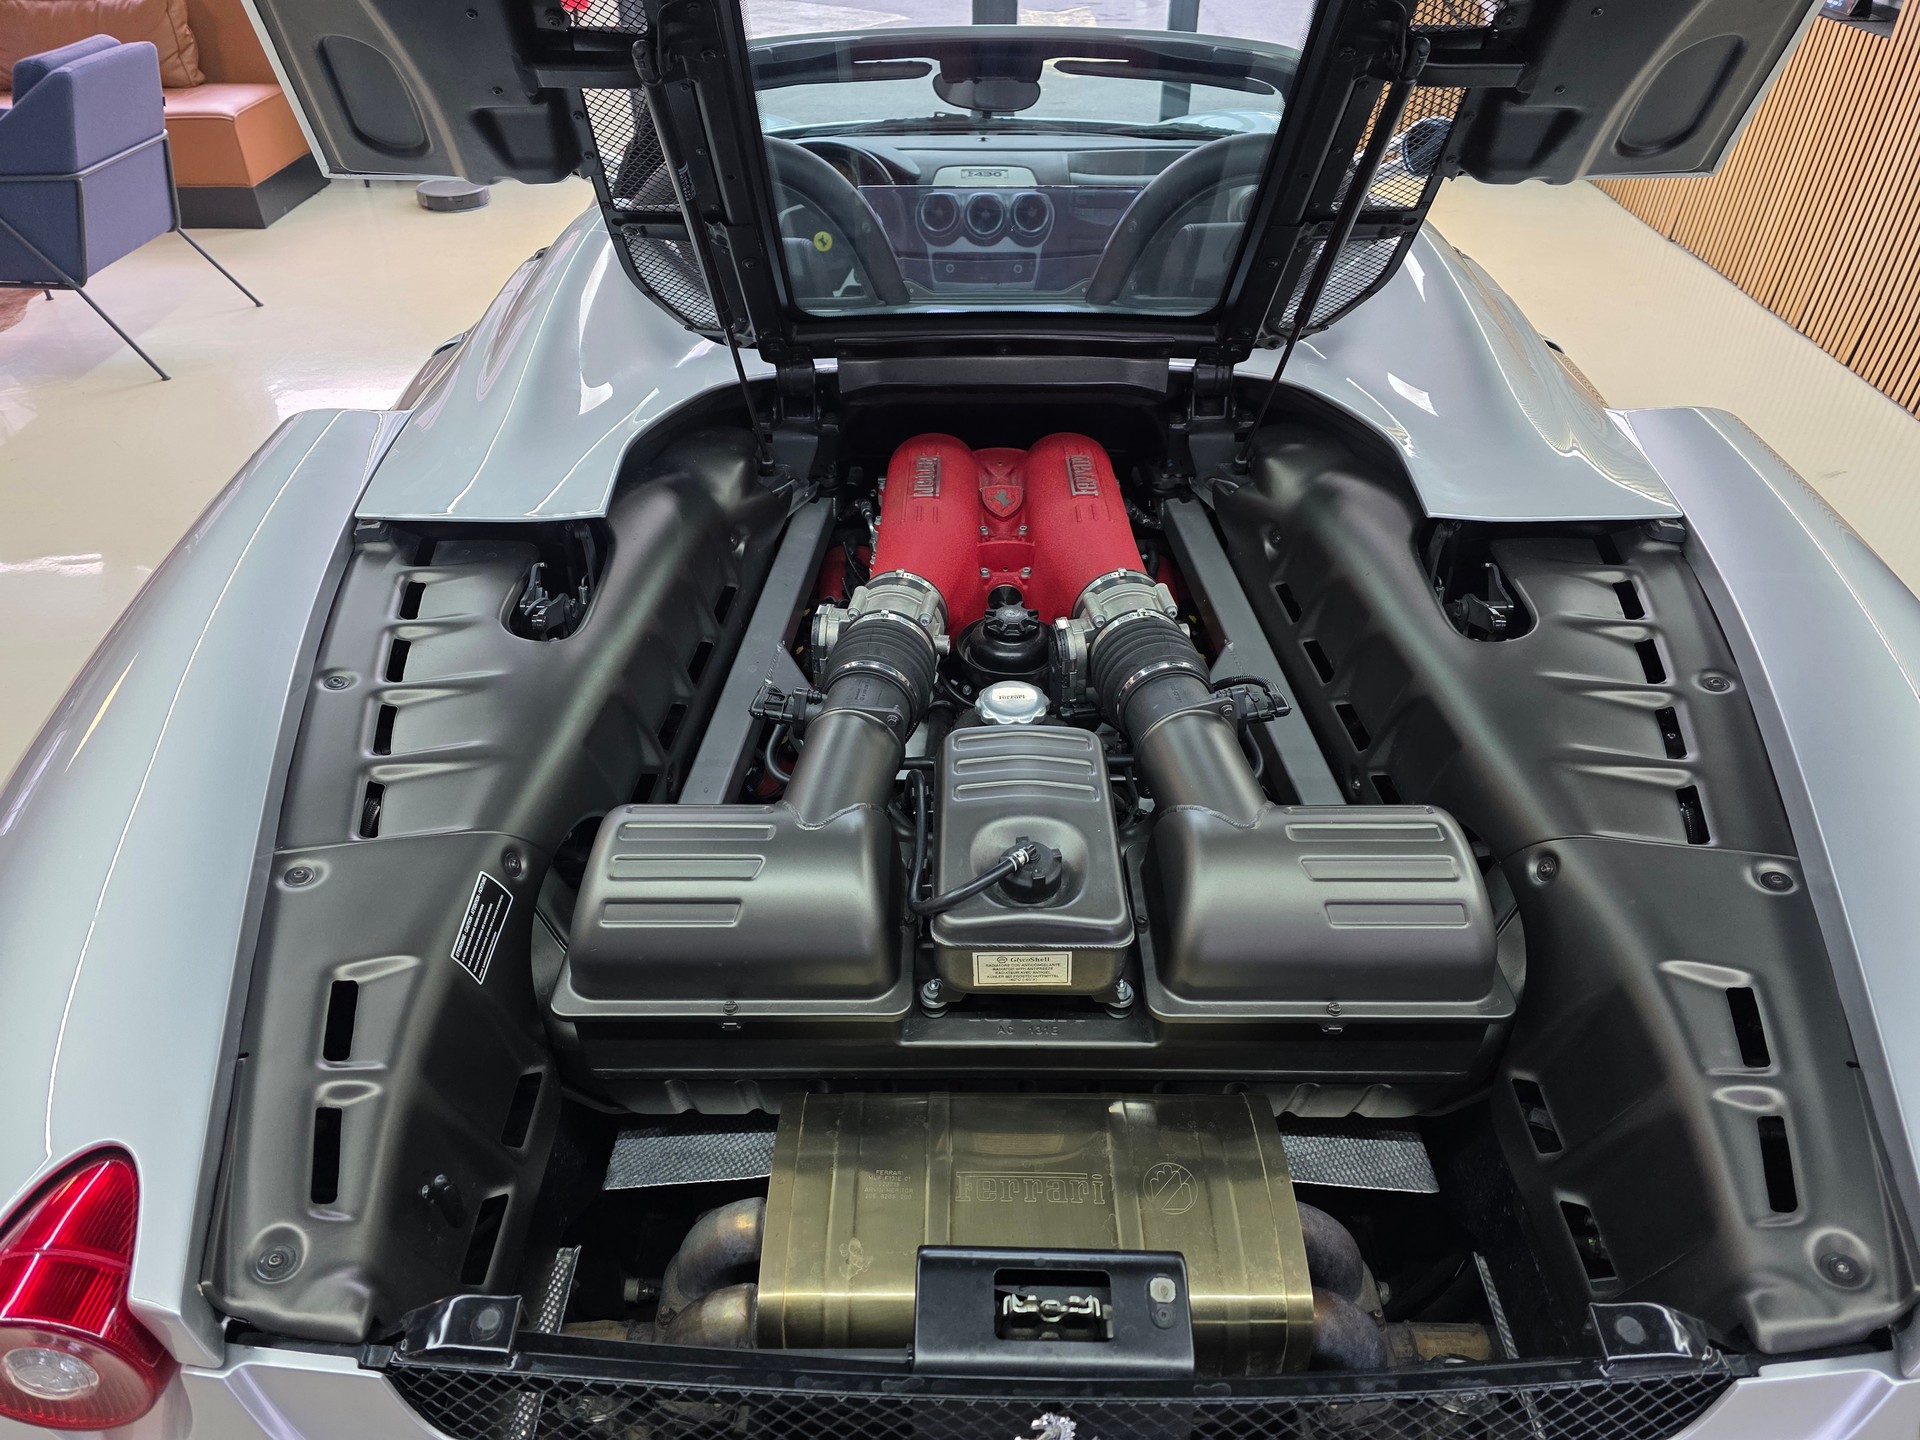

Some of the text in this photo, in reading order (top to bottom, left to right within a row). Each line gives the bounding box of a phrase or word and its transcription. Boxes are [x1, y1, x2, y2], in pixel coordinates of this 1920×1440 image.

[913, 456, 941, 498] Ferrari
[1065, 454, 1099, 497] Ferrari
[464, 915, 474, 934] CAUTION
[998, 1025, 1014, 1035] AC
[955, 1170, 1106, 1205] Ferrari
